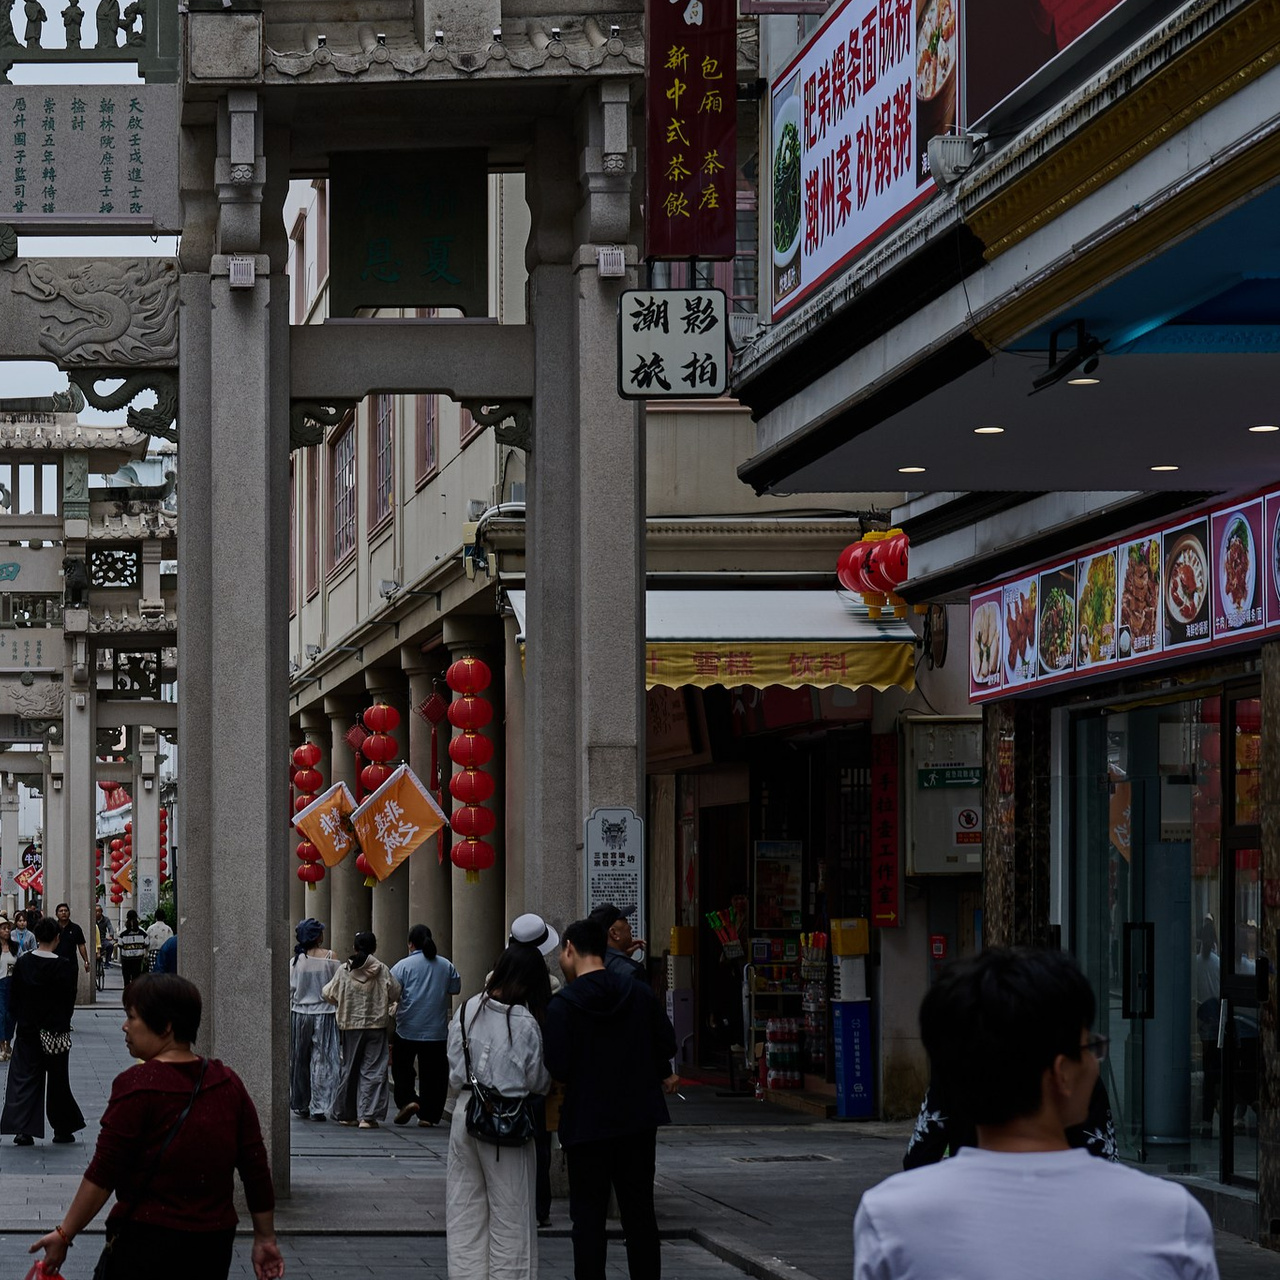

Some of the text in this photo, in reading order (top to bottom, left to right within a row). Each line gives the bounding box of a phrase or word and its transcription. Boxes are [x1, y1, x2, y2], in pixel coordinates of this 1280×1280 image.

[699, 151, 725, 210] 茶座
[805, 76, 913, 257] 潮州菜 砂锅粥
[693, 651, 754, 676] 雪糕
[787, 652, 849, 678] 饮料
